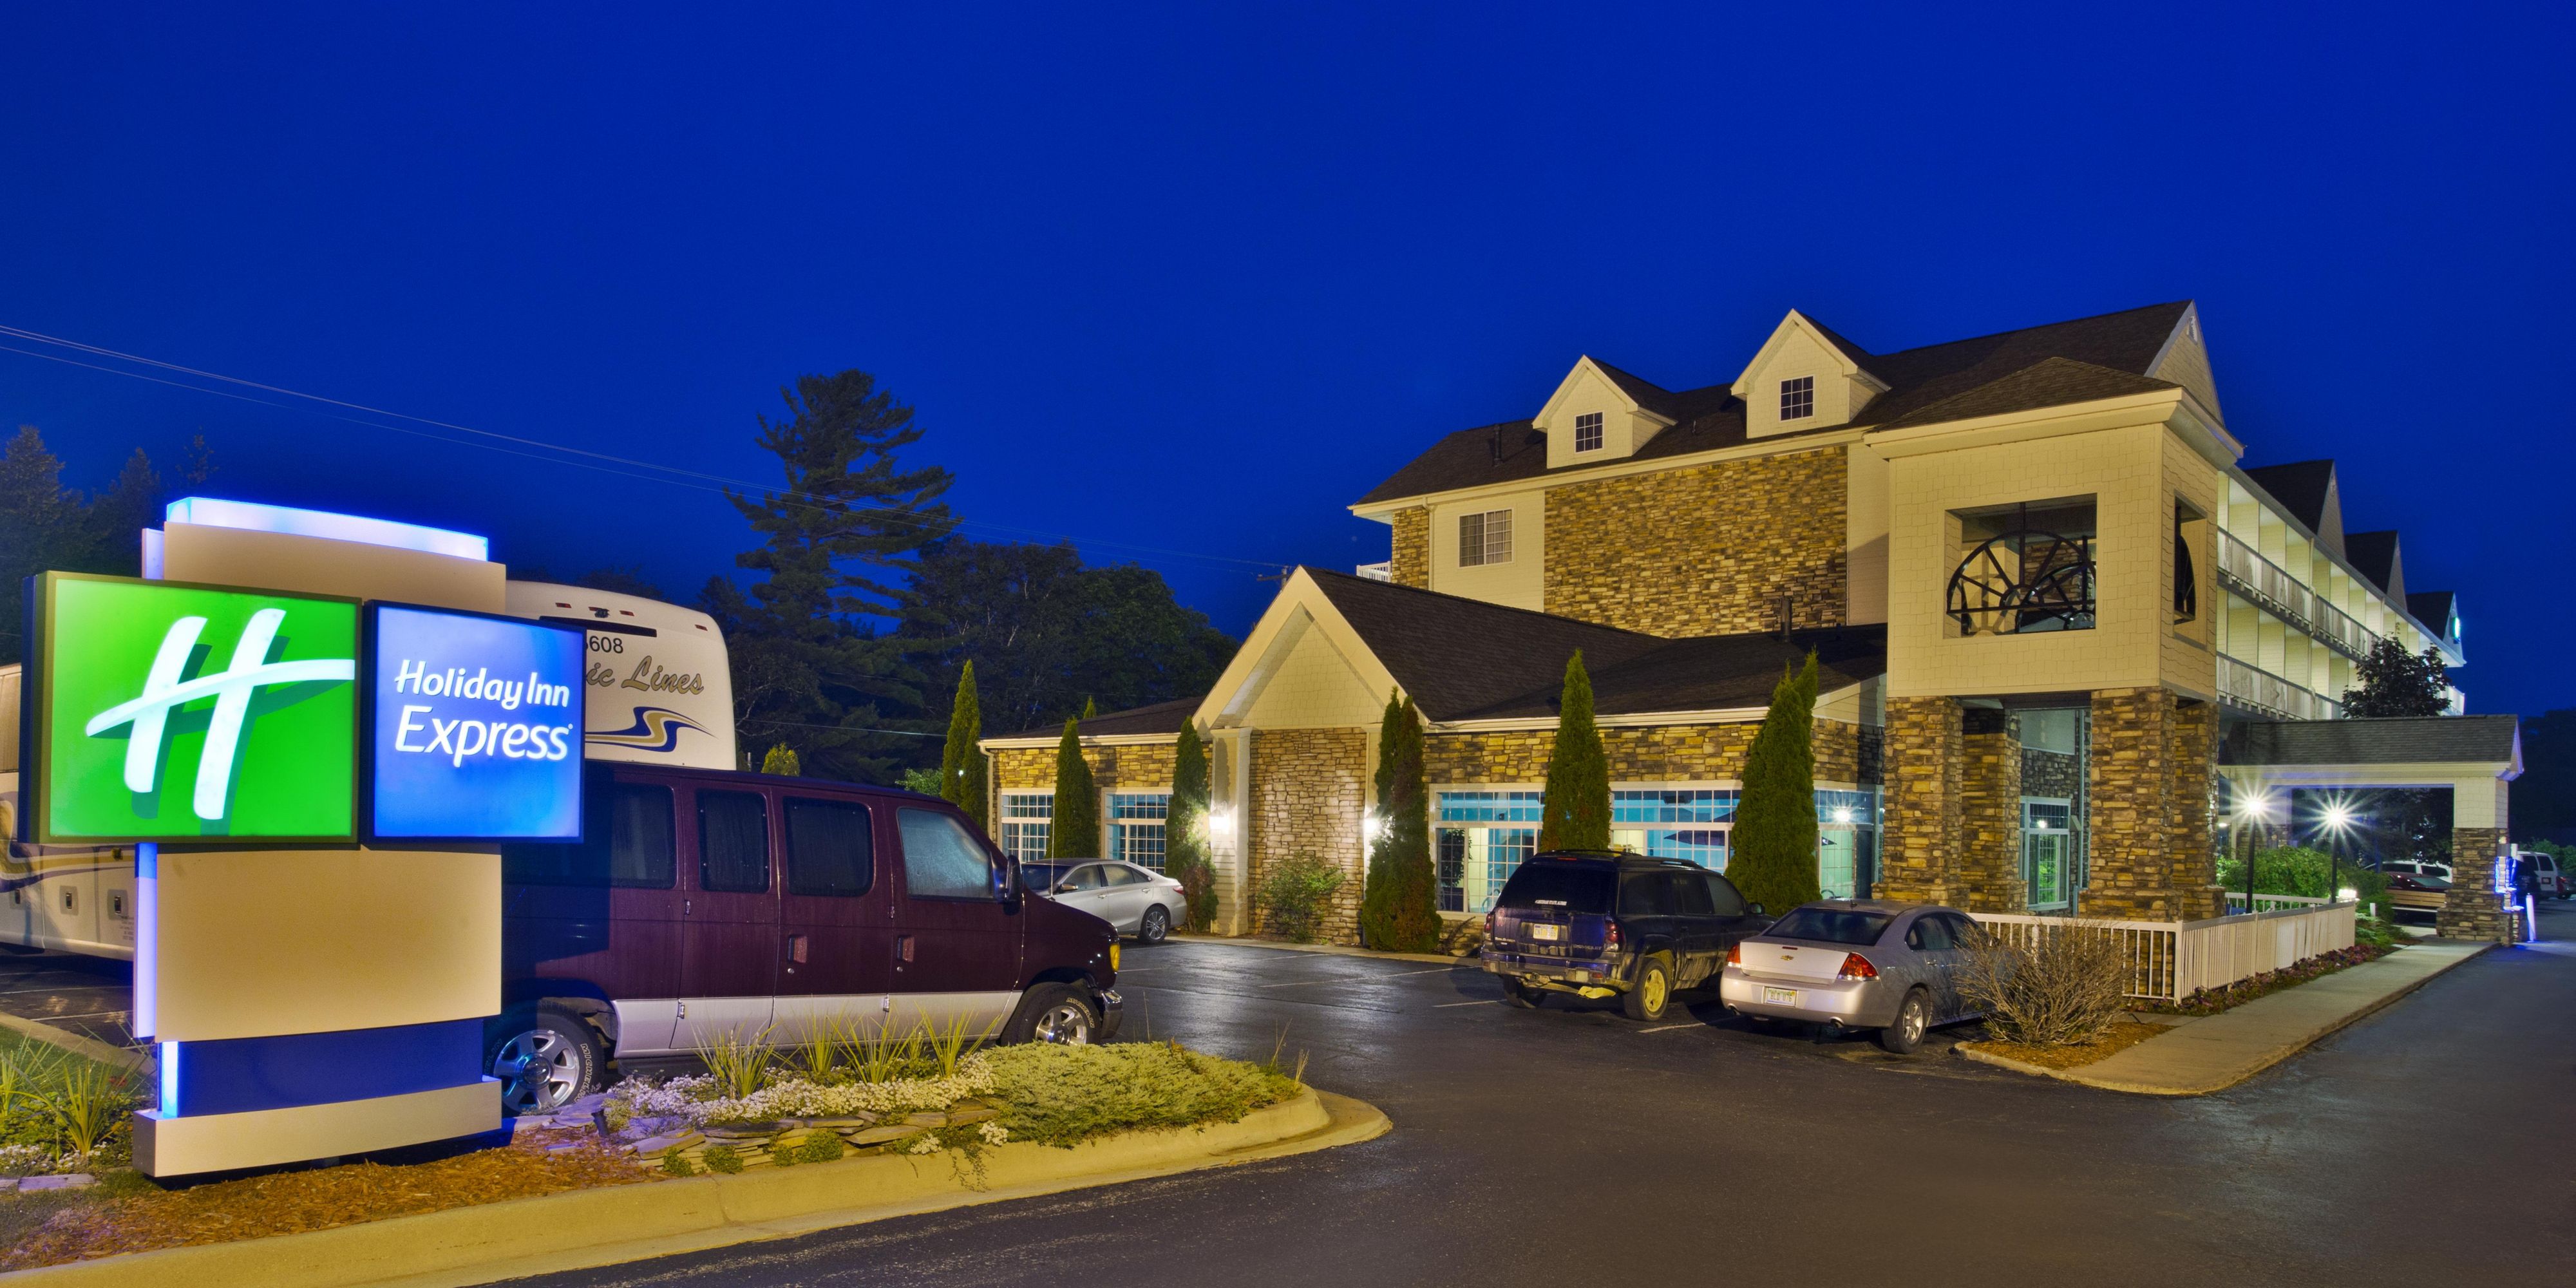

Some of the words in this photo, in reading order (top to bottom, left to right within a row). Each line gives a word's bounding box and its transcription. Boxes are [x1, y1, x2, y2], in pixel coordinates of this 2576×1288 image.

[587, 636, 623, 654] 608
[394, 659, 524, 710] Holiday
[526, 672, 570, 707] Inn
[621, 655, 704, 695] Lines
[85, 608, 355, 820] H
[395, 705, 570, 768] Express
